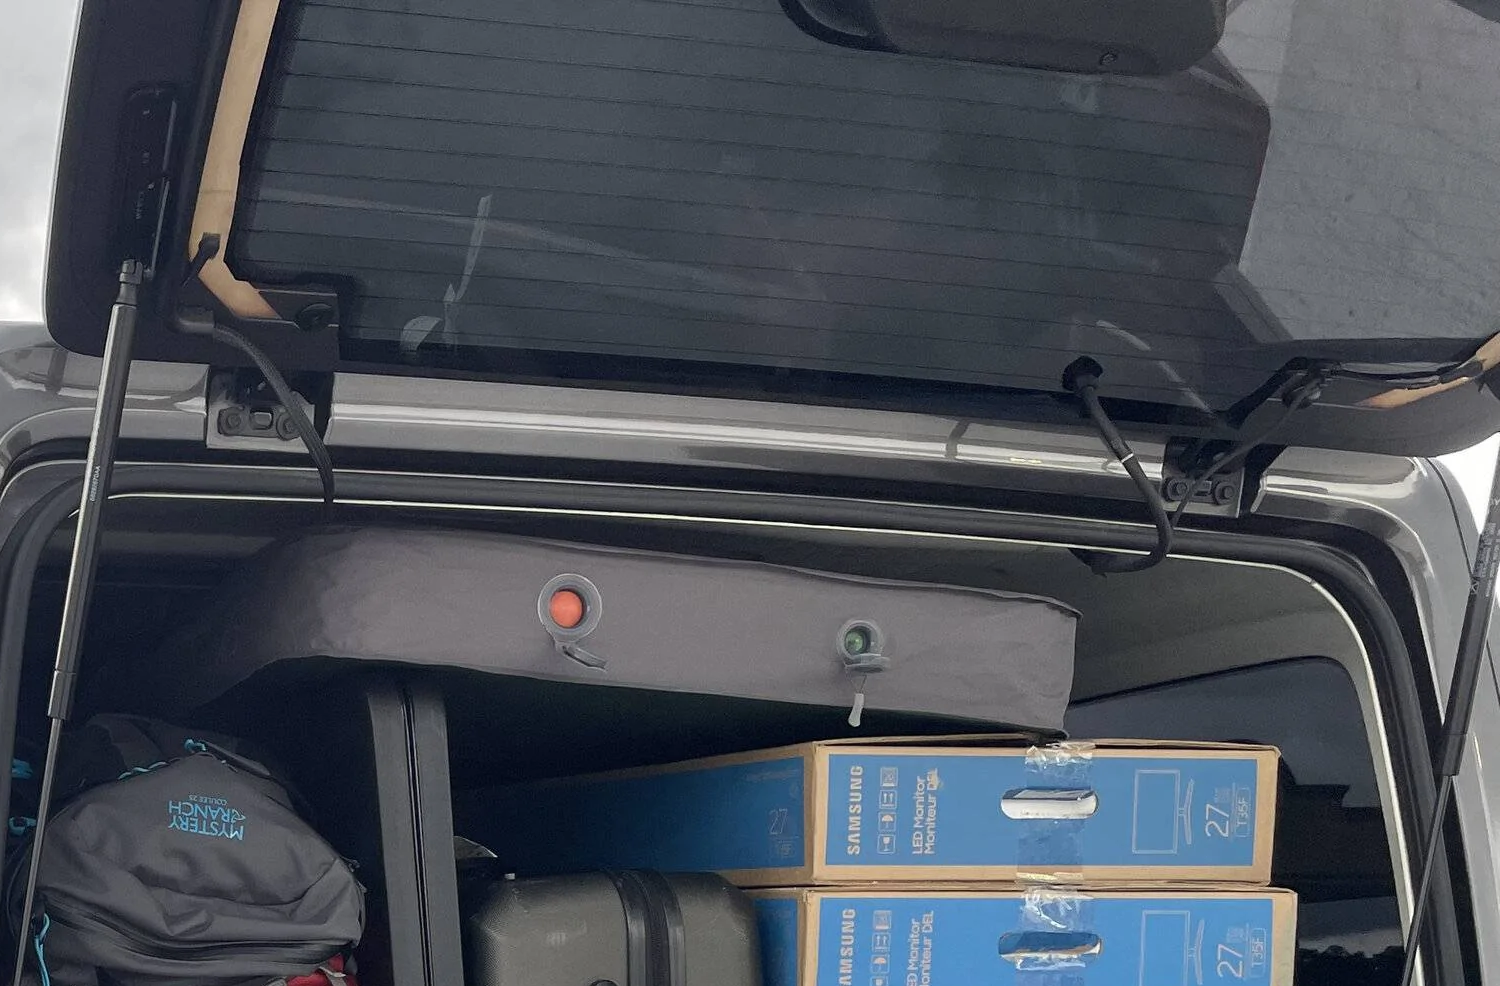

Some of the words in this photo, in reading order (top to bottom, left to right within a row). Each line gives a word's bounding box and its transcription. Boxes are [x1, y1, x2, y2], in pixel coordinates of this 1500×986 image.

[169, 800, 231, 822] RANCH
[847, 765, 863, 855] SAMSUNG
[913, 775, 925, 828] Monitor
[168, 815, 244, 840] MYSTERY
[924, 794, 936, 854] Moniteur
[1205, 803, 1230, 837] 27
[912, 832, 923, 854] LED
[922, 910, 934, 933] DEL
[907, 918, 920, 970] Monitor
[1217, 943, 1243, 978] 27
